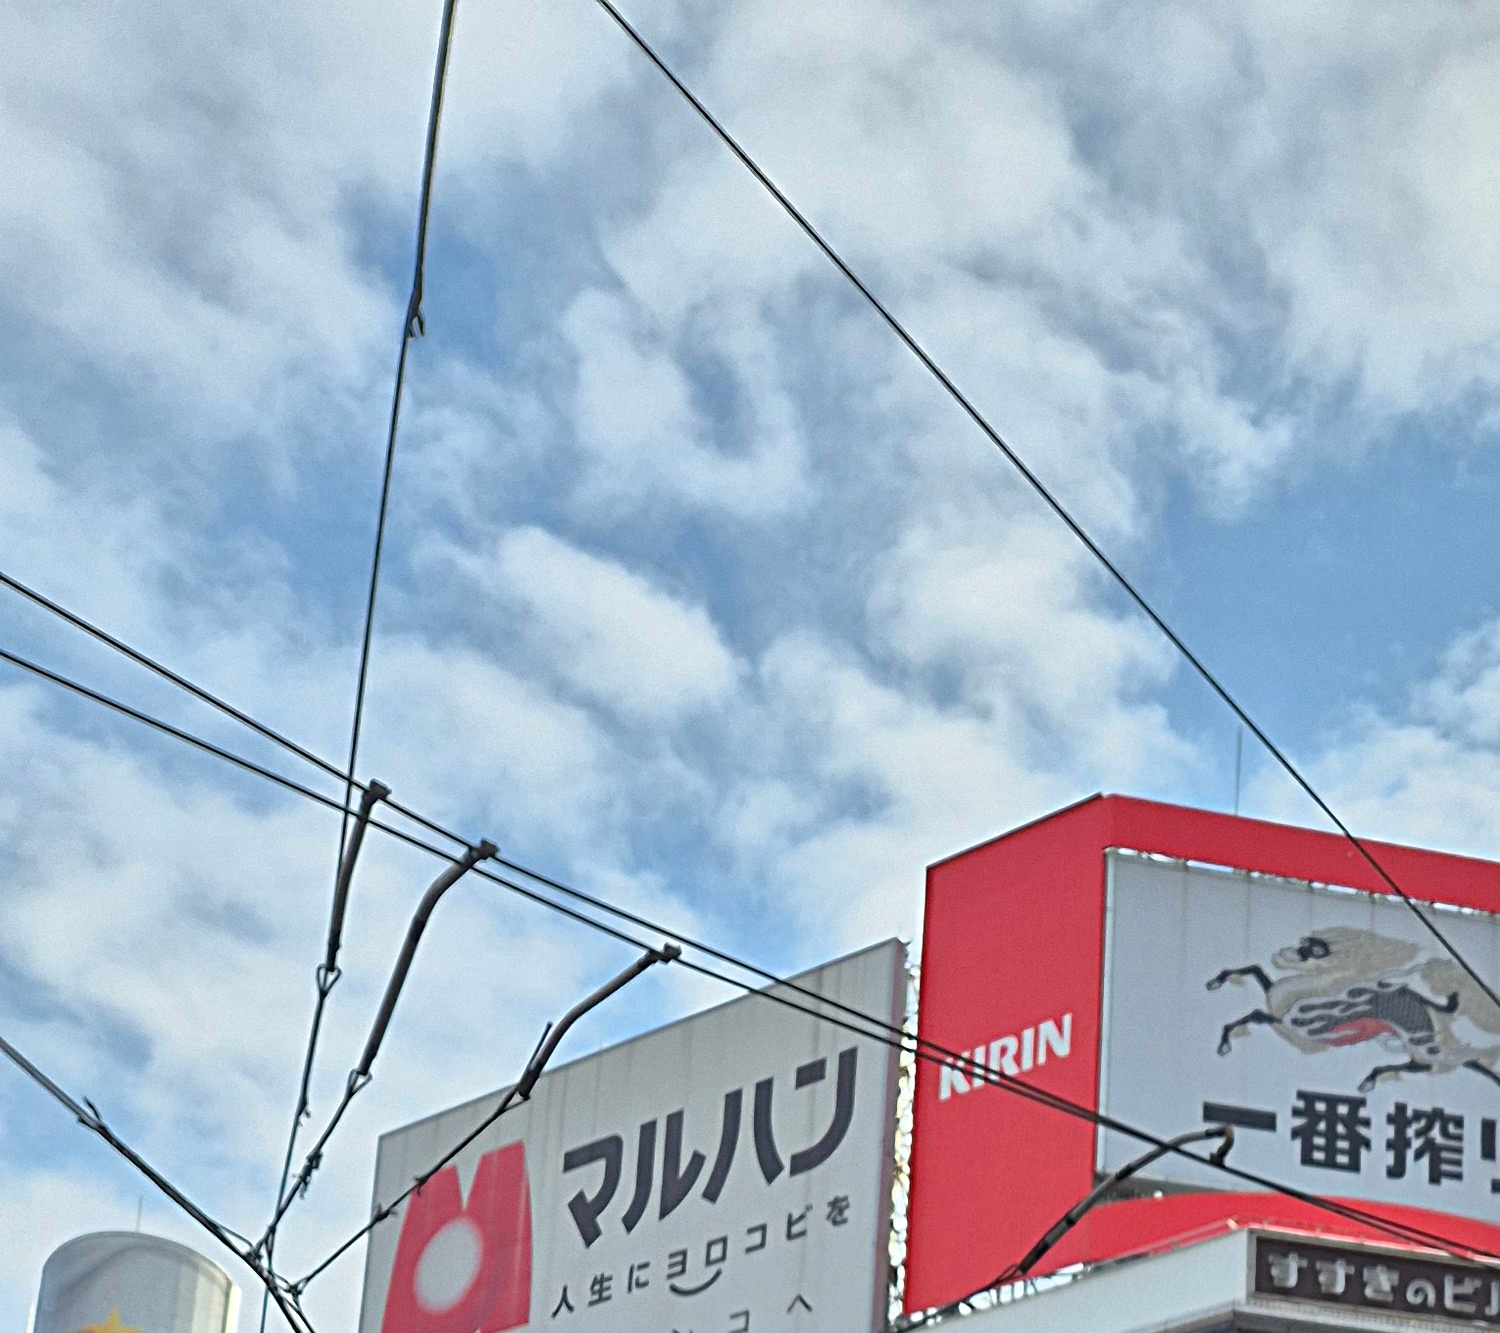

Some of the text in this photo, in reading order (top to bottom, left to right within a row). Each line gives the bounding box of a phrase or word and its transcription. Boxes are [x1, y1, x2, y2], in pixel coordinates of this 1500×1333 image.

[939, 1013, 1073, 1102] KIRIN
[562, 1046, 859, 1249] マルハン
[550, 1196, 852, 1319] 人生にヨロコビを
